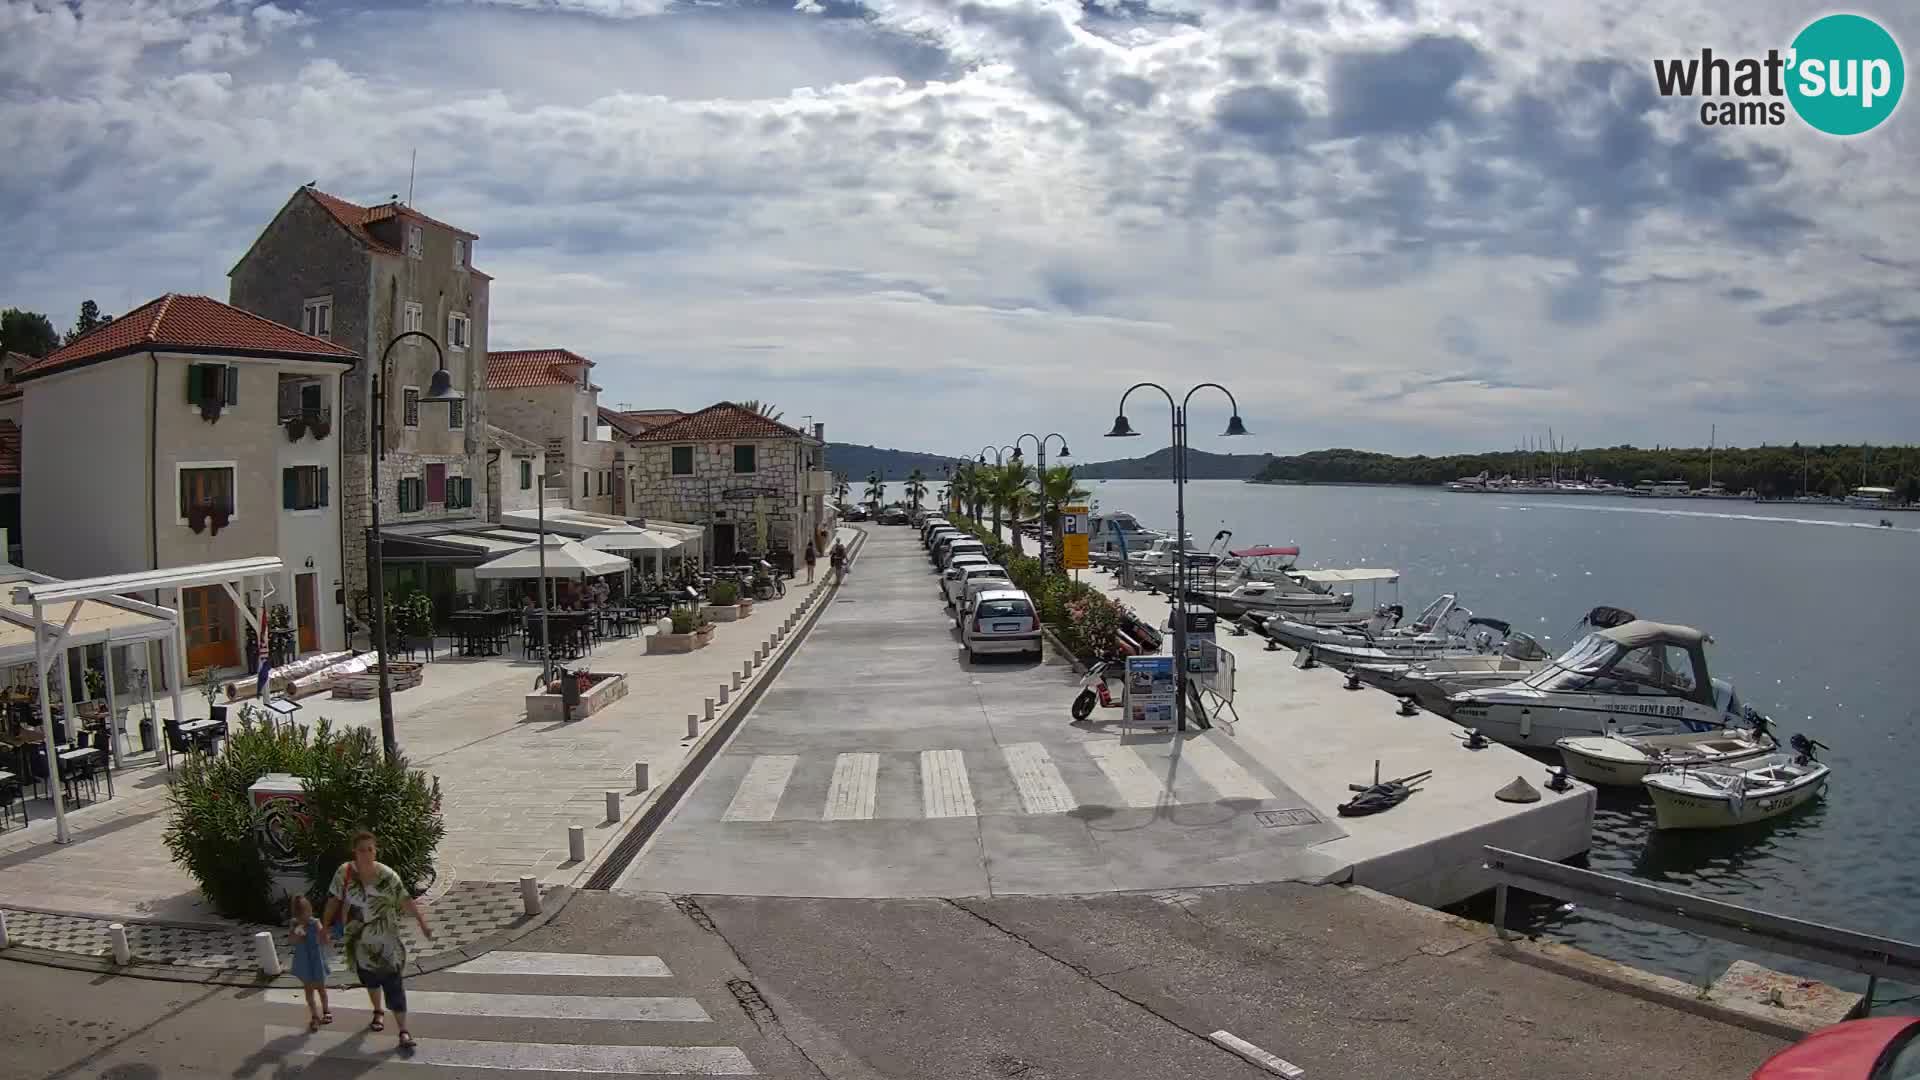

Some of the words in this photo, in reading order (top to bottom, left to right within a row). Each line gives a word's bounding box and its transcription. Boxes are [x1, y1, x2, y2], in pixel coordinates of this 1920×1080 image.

[1065, 516, 1076, 532] P
[1639, 703, 1658, 714] RENT
[1666, 704, 1685, 717] BOAT
